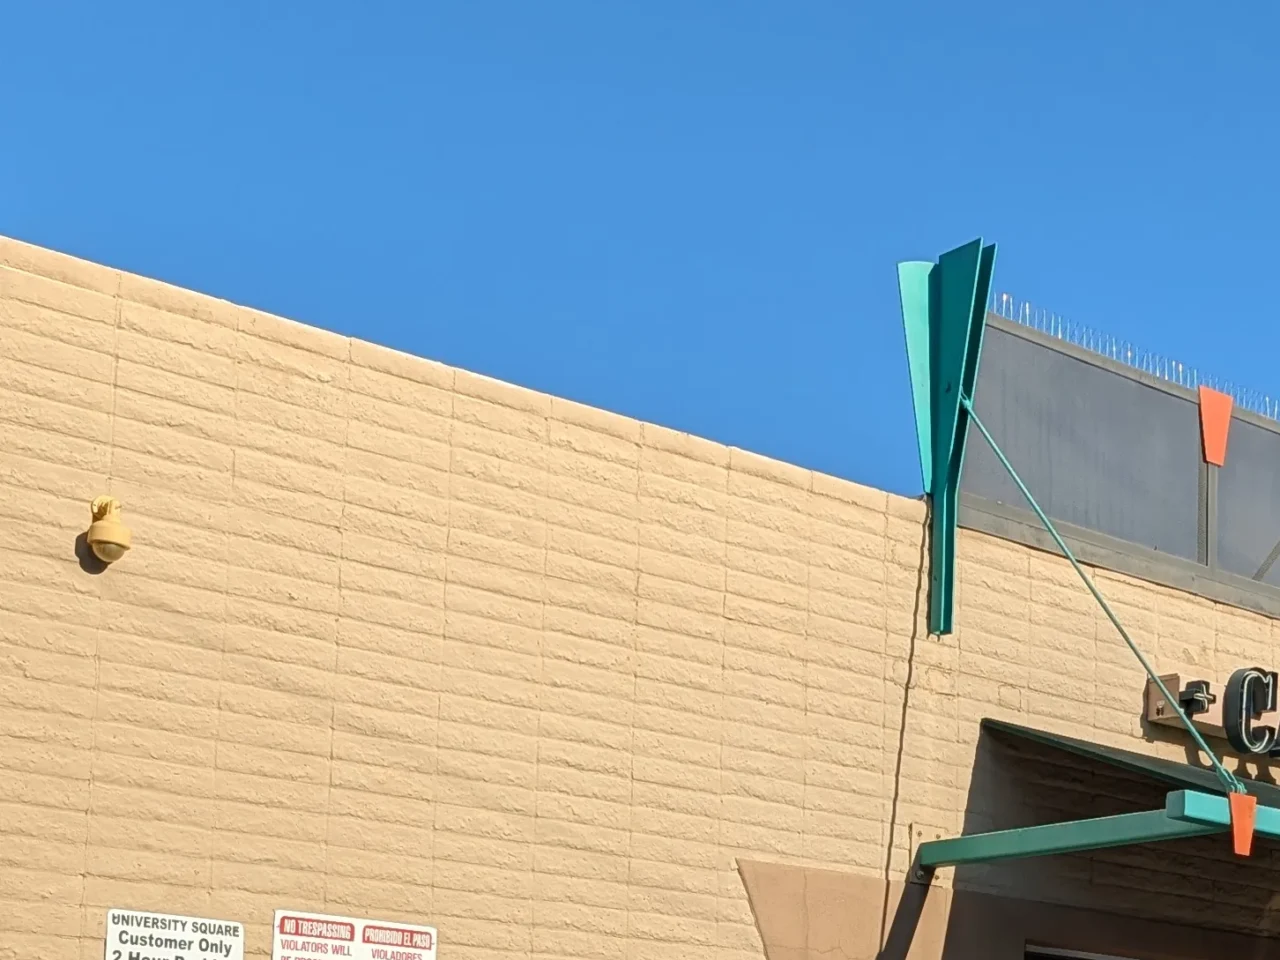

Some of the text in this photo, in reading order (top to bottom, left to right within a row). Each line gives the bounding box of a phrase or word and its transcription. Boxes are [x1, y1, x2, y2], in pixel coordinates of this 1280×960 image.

[112, 913, 240, 937] UNIVERSITY SQUARE
[283, 918, 351, 940] NO TRESPASSING
[118, 930, 232, 957] Customer Only
[280, 939, 352, 957] VIOLATORS WILL
[412, 933, 431, 948] PASO
